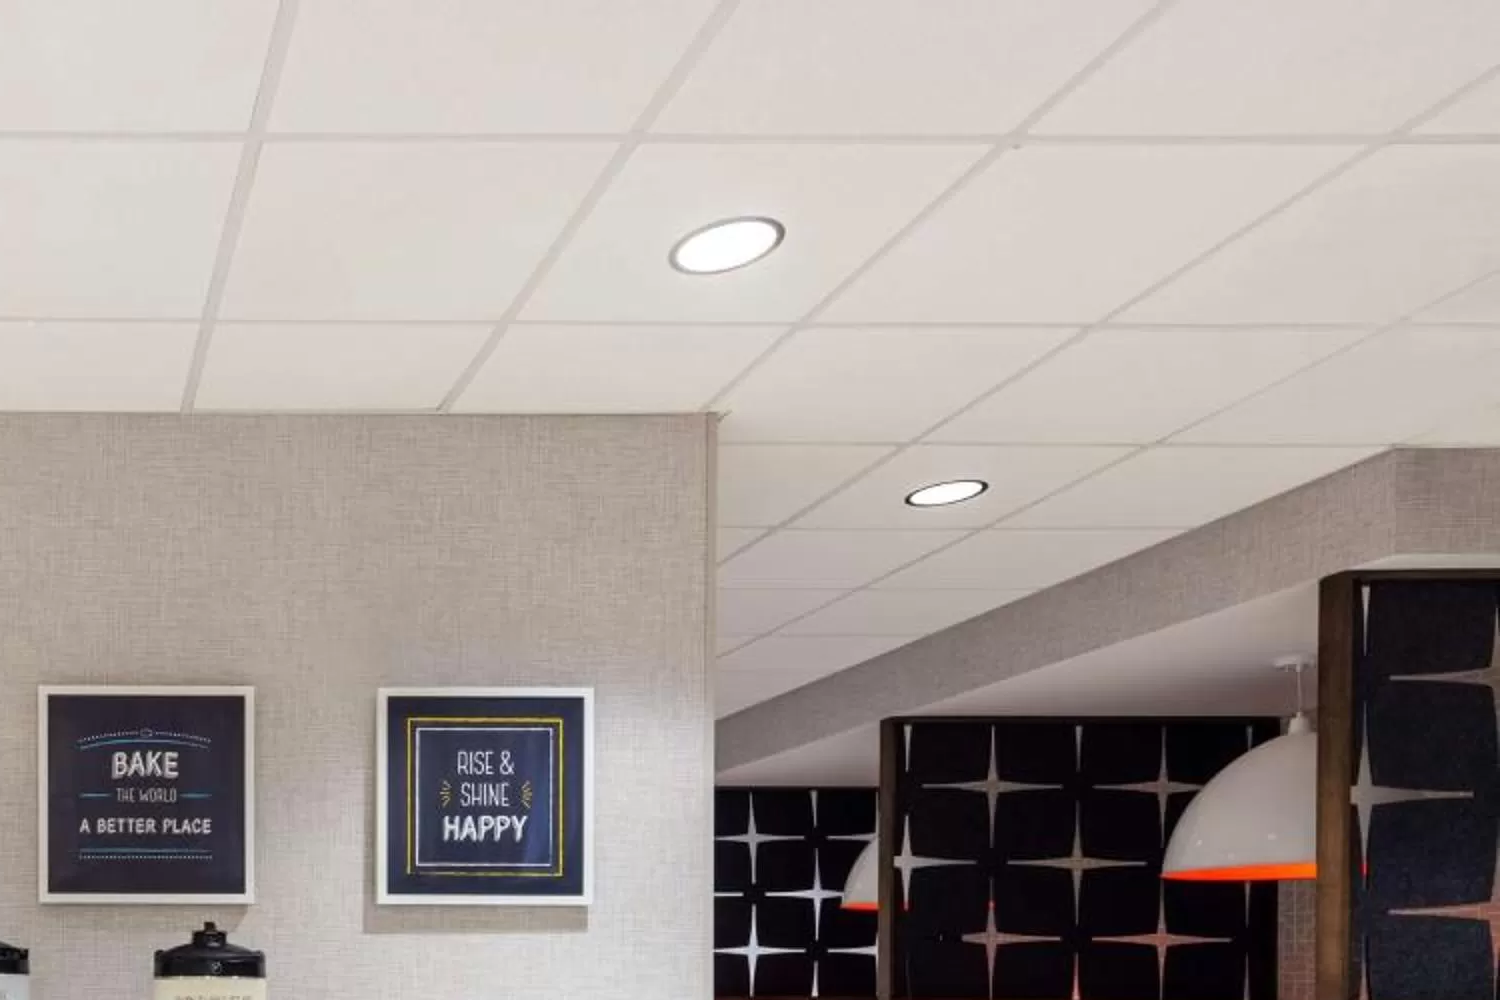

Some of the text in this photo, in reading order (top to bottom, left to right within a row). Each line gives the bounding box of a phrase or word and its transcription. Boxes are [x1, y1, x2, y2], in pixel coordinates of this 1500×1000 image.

[111, 750, 180, 779] BAKE
[456, 750, 515, 775] RISE &
[115, 787, 178, 804] THE WORLD
[460, 782, 510, 807] SHINE
[78, 818, 213, 835] A BETTER PLACE
[442, 814, 529, 843] HAPPY
